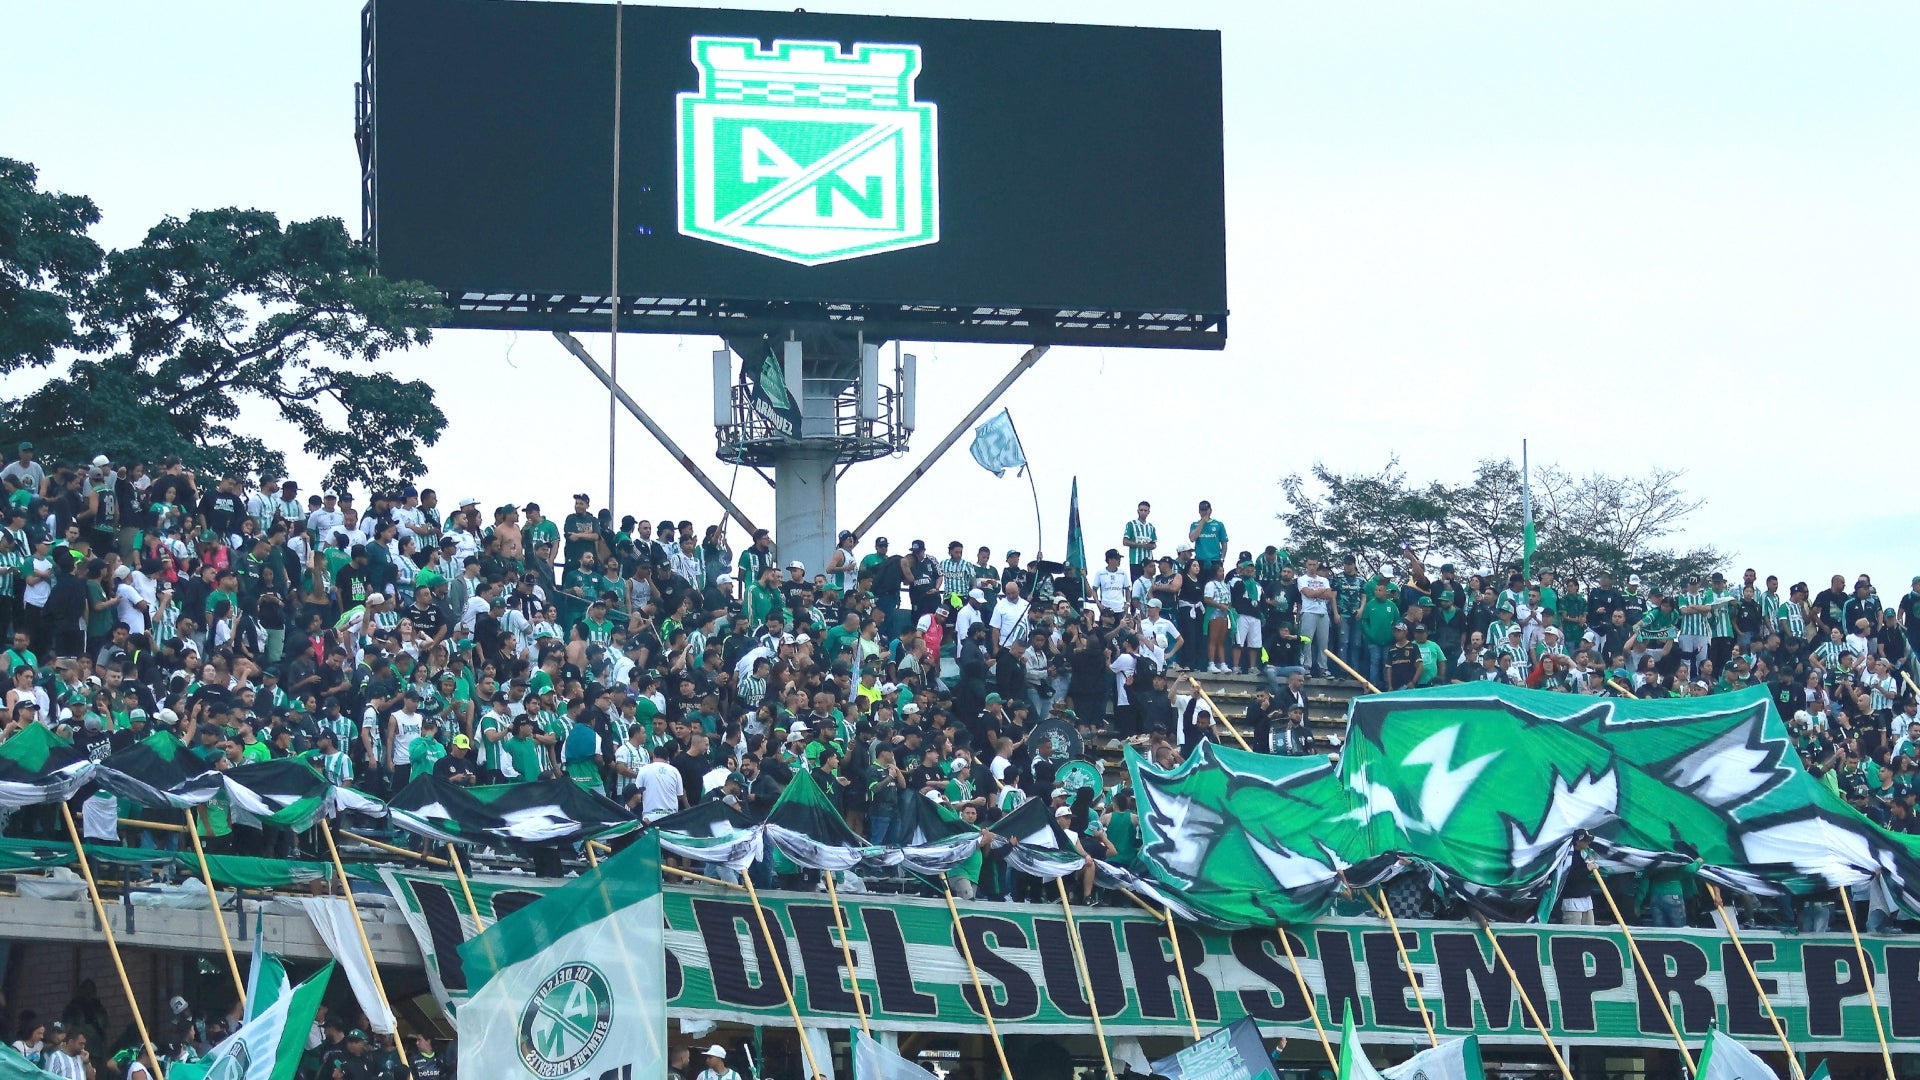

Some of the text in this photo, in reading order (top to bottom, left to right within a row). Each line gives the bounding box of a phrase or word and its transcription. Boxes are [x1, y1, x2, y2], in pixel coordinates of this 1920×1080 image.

[691, 896, 939, 1019] DEL
[952, 914, 1221, 1023] SUR
[1229, 926, 1788, 1039] SIEMPRE
